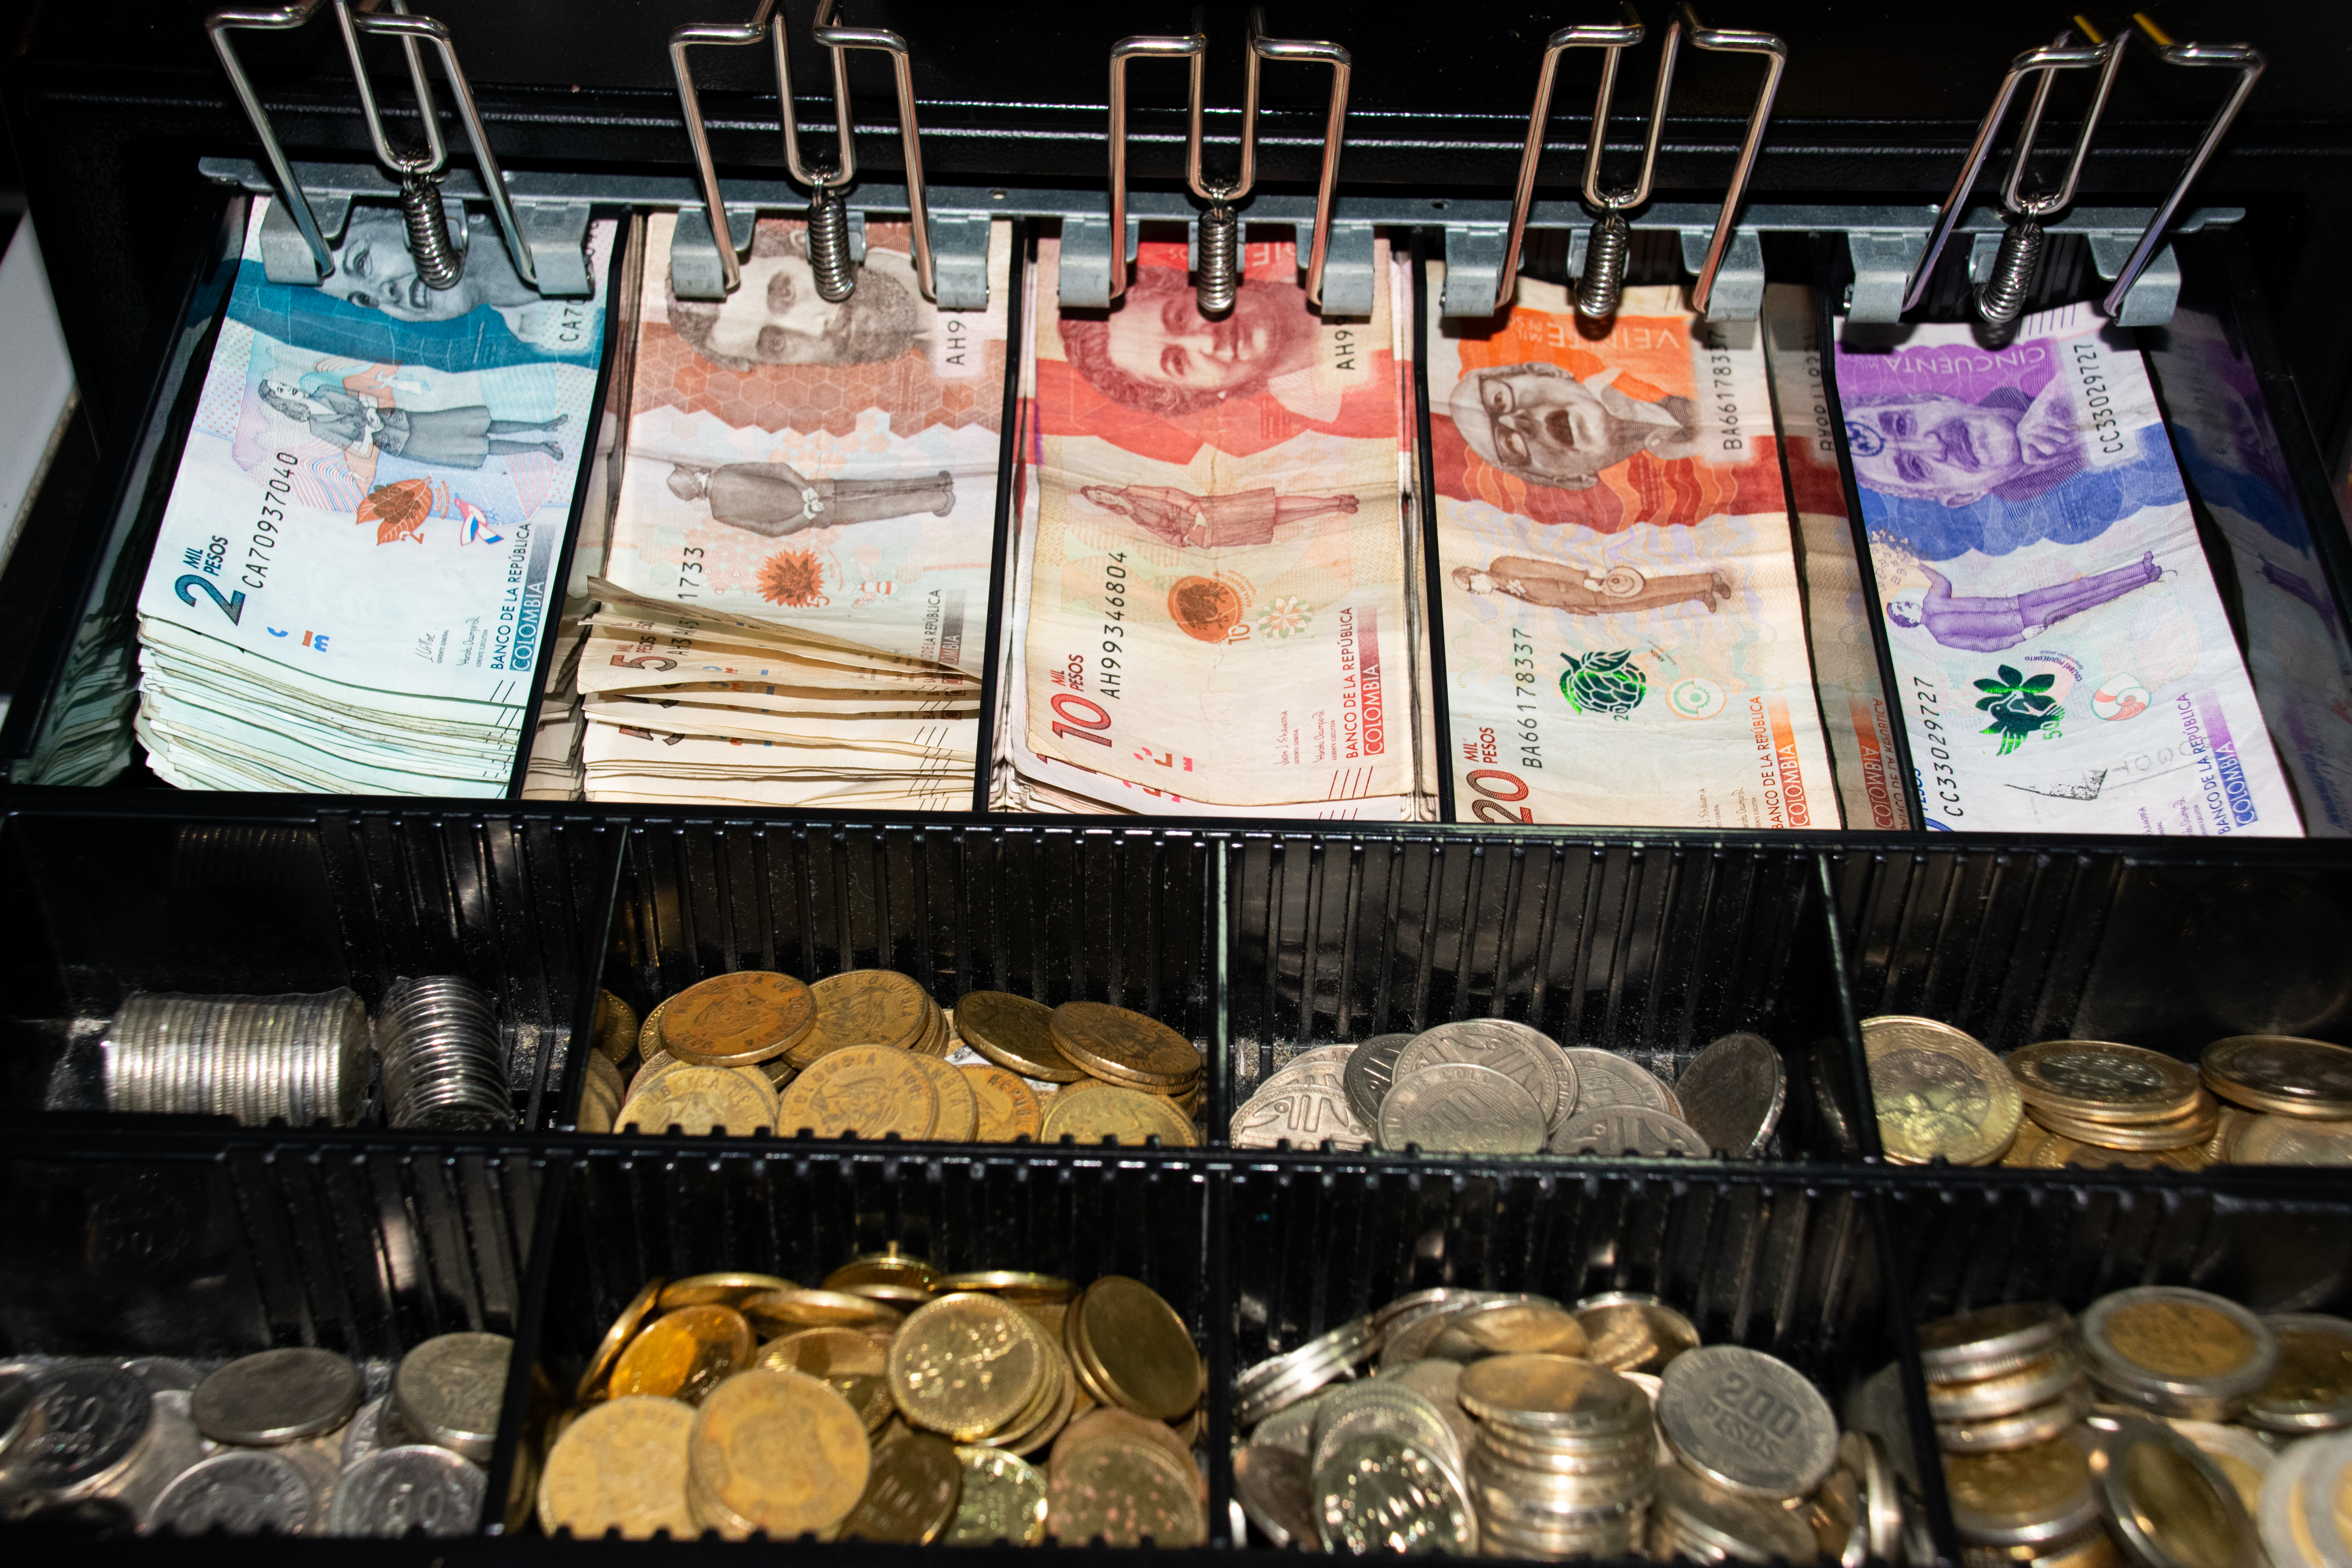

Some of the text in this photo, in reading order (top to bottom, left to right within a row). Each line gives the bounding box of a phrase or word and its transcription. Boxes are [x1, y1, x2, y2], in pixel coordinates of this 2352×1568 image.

[1883, 347, 2045, 374] CINCUENTA
[2073, 344, 2124, 453] CC33029727
[242, 452, 298, 588] CA70937040
[183, 547, 203, 569] MIL
[203, 535, 229, 577] PESOS
[678, 547, 704, 599] 1733
[174, 574, 246, 626] 2
[490, 523, 531, 670] BANCO DE LA REPÚBLICA
[924, 589, 941, 635] REPÚBLICA
[512, 581, 544, 671] COLOMBIA
[635, 635, 657, 653] PESOS
[1100, 552, 1127, 700] AH99346804
[609, 654, 678, 672] 5
[1050, 670, 1066, 686] MIL
[1068, 654, 1084, 692] PESOS
[1337, 607, 1359, 759] BANCO DE LA REPÚBLICA
[2025, 655, 2065, 666] PIQUICORTO
[1050, 693, 1112, 748] 10
[1363, 663, 1383, 754] COLOMBIA
[1513, 628, 1543, 769] BA66178337
[1463, 742, 1479, 763] MIL
[1479, 727, 1498, 764] PESOS
[1913, 676, 1964, 817] CC33029727
[2040, 720, 2063, 740] 50
[1749, 696, 1784, 829] BANCO DE LA REPÚBLICA
[1778, 744, 1809, 828] COLOMBIA
[2176, 692, 2231, 835] BANCO DE LA REPÚBLICA
[2215, 741, 2255, 824] COLOMBIA
[1466, 769, 1534, 824] 20
[1751, 797, 1759, 815] EJECUTIVA
[1715, 1370, 1802, 1438] 200
